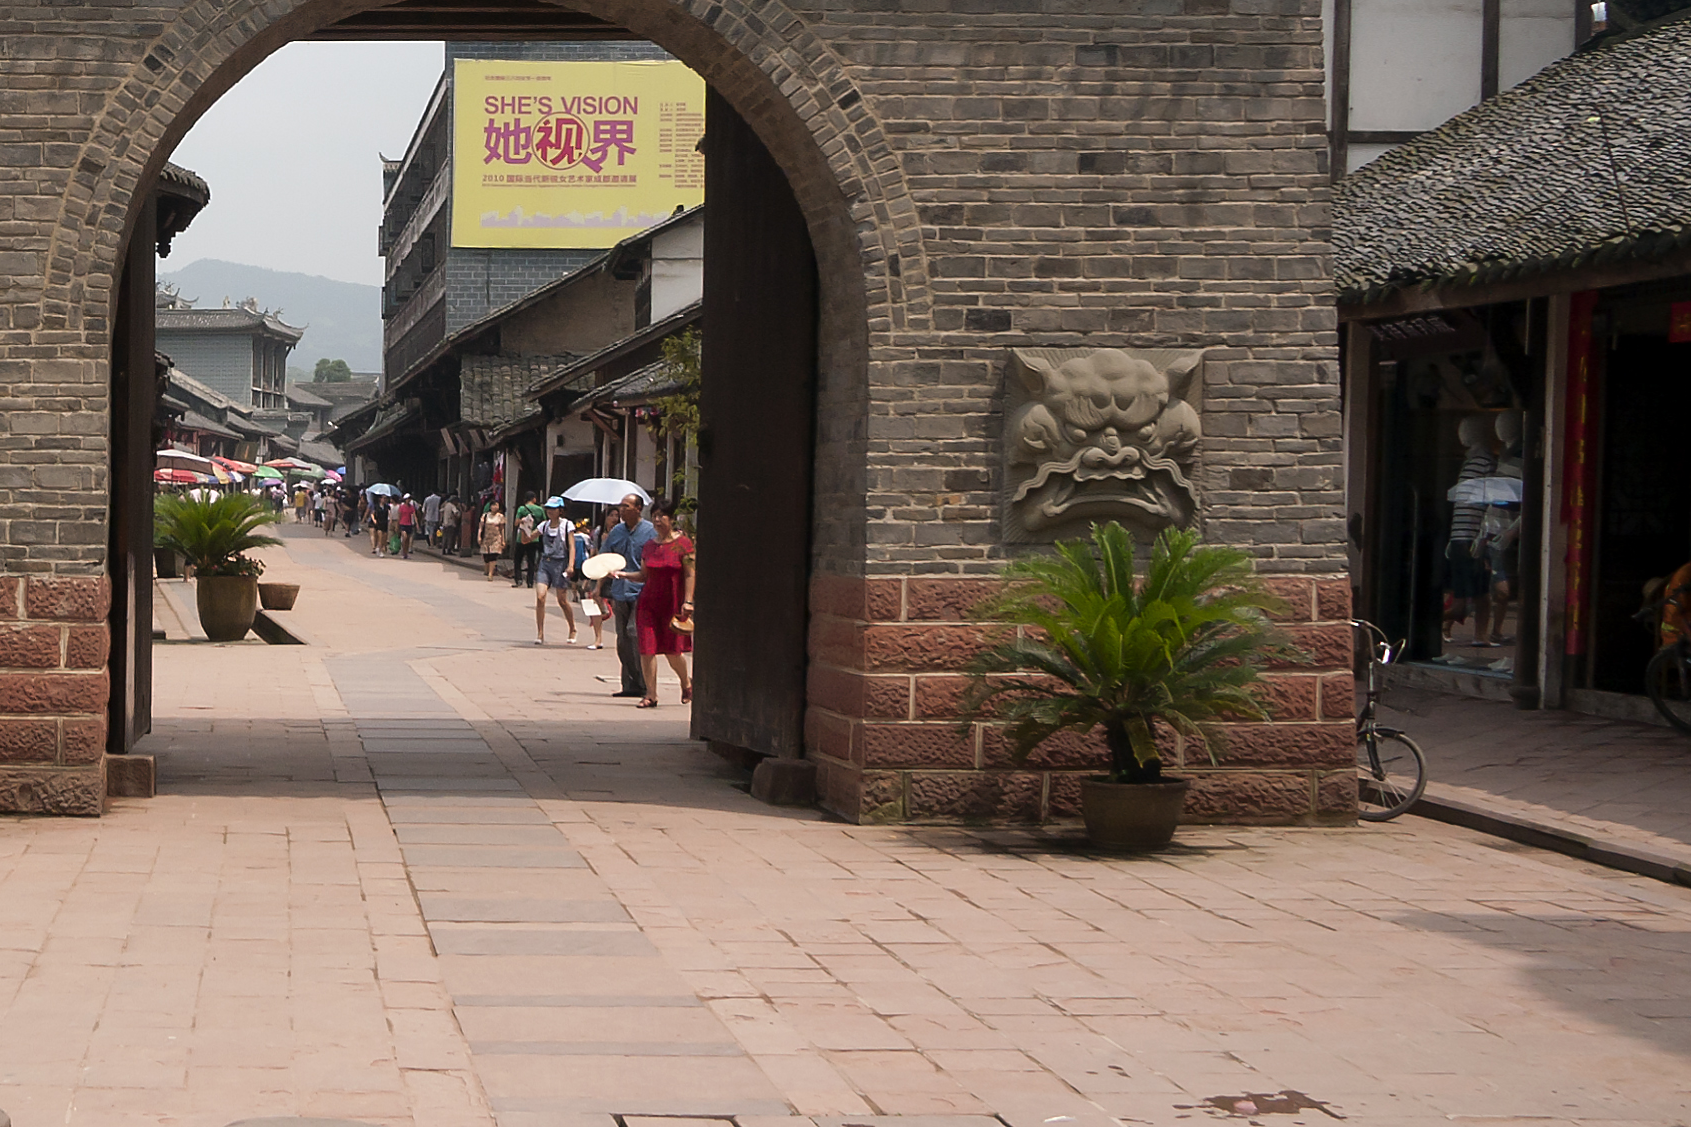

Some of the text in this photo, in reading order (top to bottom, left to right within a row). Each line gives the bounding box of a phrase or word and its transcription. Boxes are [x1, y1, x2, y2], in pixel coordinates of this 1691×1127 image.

[560, 95, 639, 115] VISION
[483, 117, 638, 174] 她视界
[482, 174, 505, 183] 2010
